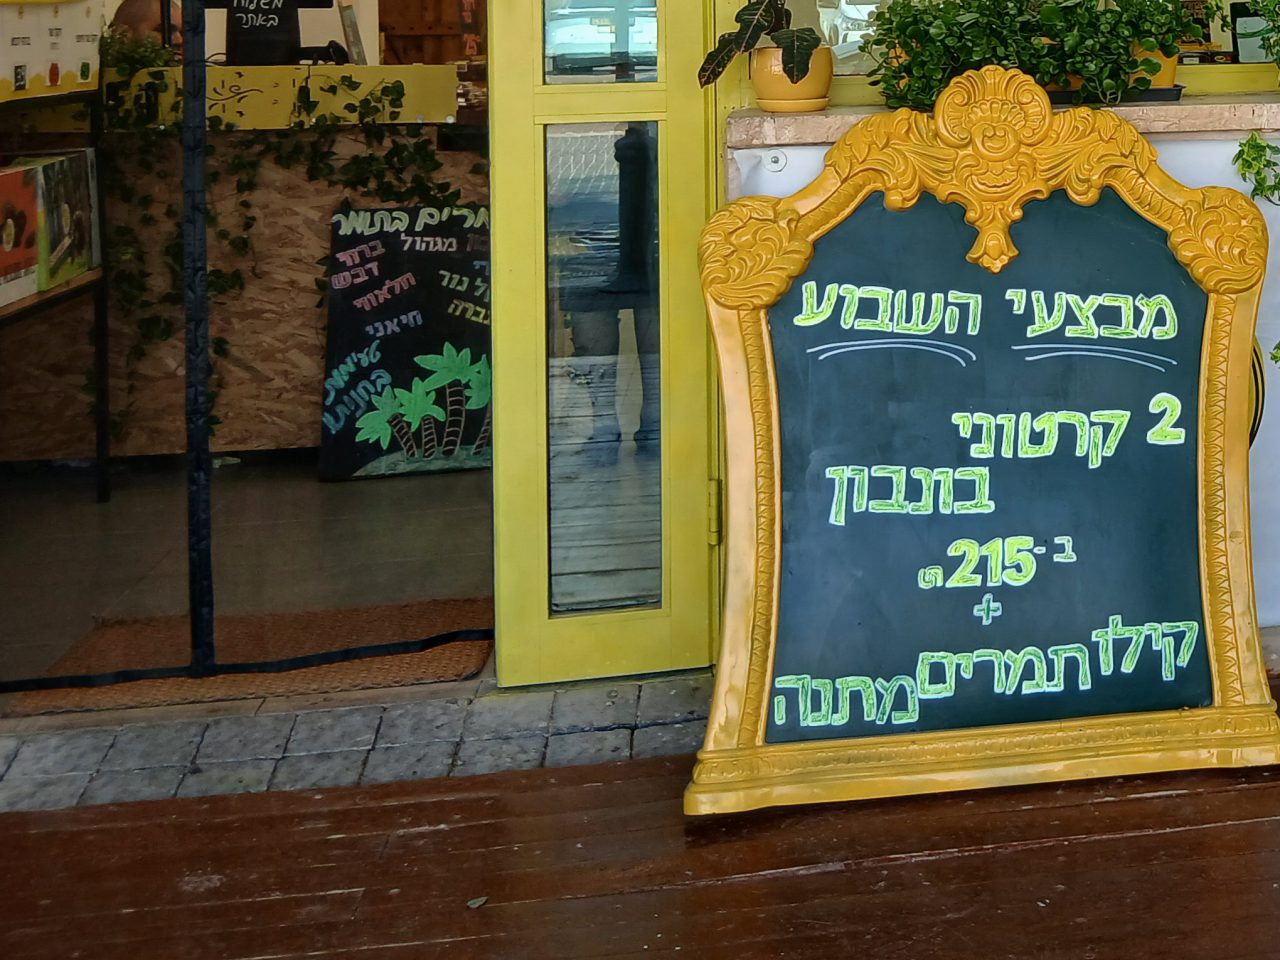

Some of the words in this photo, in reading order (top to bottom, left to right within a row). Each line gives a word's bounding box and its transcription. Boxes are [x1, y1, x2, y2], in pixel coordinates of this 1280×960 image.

[235, 13, 279, 28] באתר
[400, 232, 458, 252] מגהול
[415, 206, 489, 232] מרים
[330, 260, 380, 290] דבש
[792, 280, 983, 336] השבוע
[1004, 286, 1178, 339] מבצעי
[950, 408, 1131, 469] קרטוני
[1146, 391, 1186, 446] 2
[825, 464, 996, 526] בונבון
[918, 642, 1092, 698] תמרים
[1091, 614, 1199, 681] קילו
[773, 673, 920, 727] מתנה
